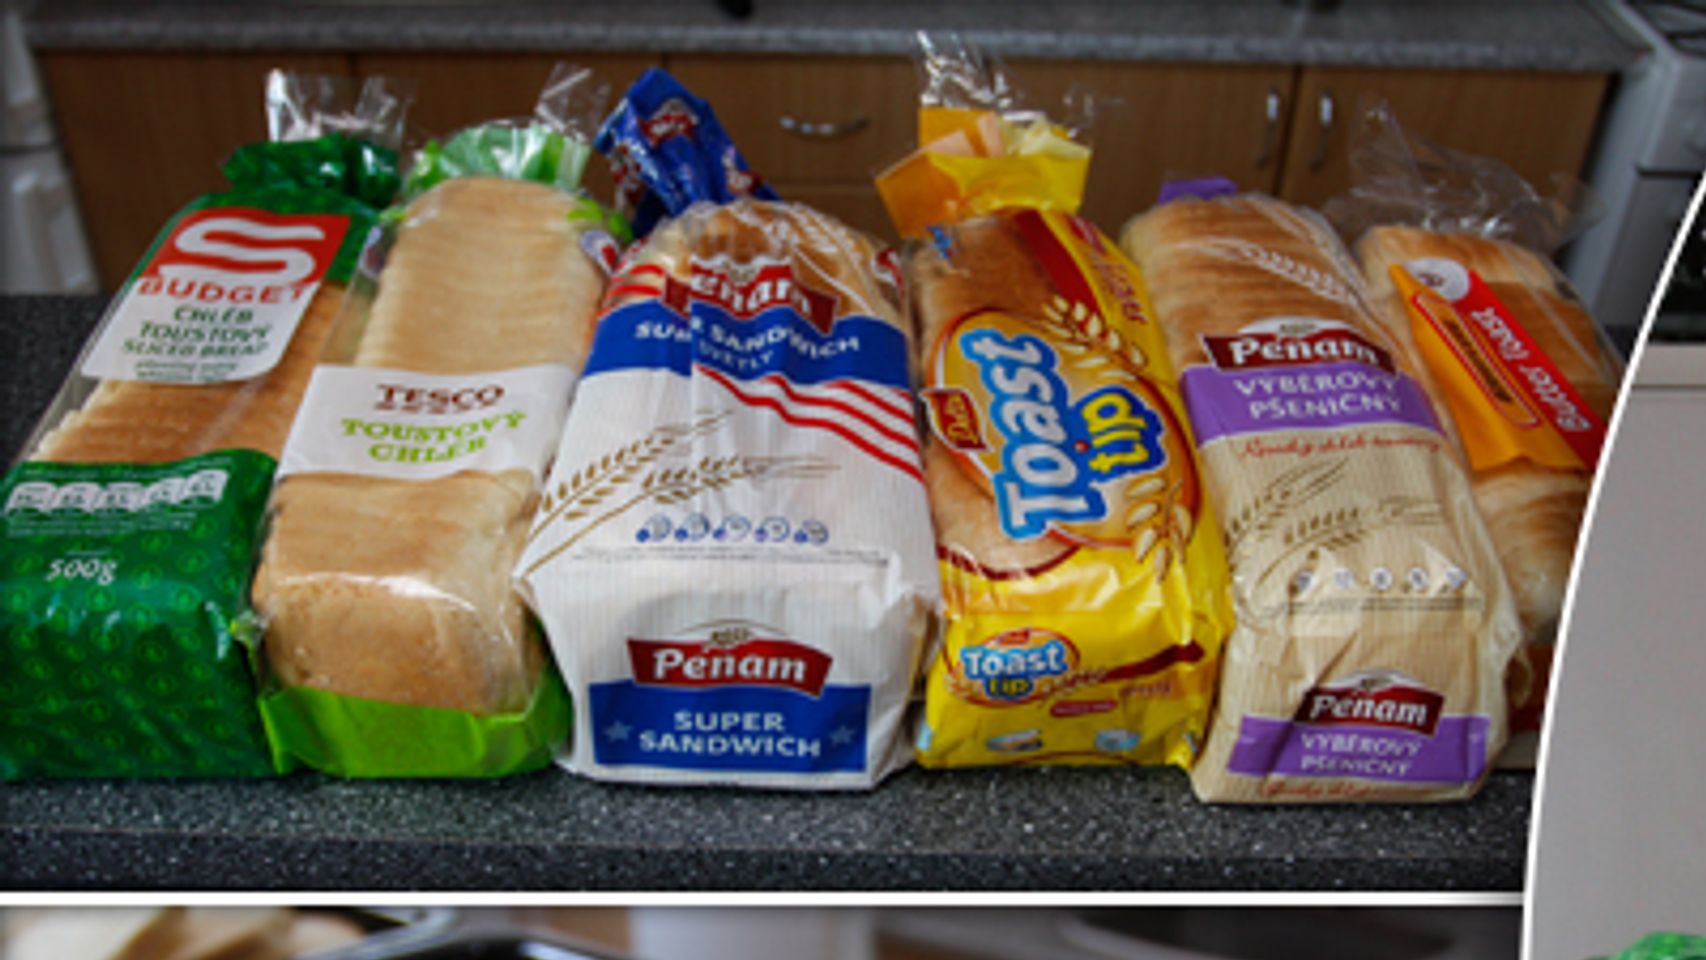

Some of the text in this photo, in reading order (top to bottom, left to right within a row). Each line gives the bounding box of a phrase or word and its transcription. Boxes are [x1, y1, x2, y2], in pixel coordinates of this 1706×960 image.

[136, 276, 309, 304] BUDGET
[1470, 306, 1532, 363] Toast
[1229, 338, 1380, 366] Penam
[375, 383, 505, 408] TESCO
[1518, 364, 1592, 433] Butter
[972, 336, 1090, 528] Toast
[1082, 393, 1151, 473] tip
[45, 558, 117, 586] 500g
[653, 648, 807, 682] Penam
[968, 646, 1063, 678] Toast
[989, 676, 1030, 696] tip
[673, 709, 786, 733] SUPER
[1309, 694, 1428, 727] Penam
[639, 731, 822, 758] SANDWICH
